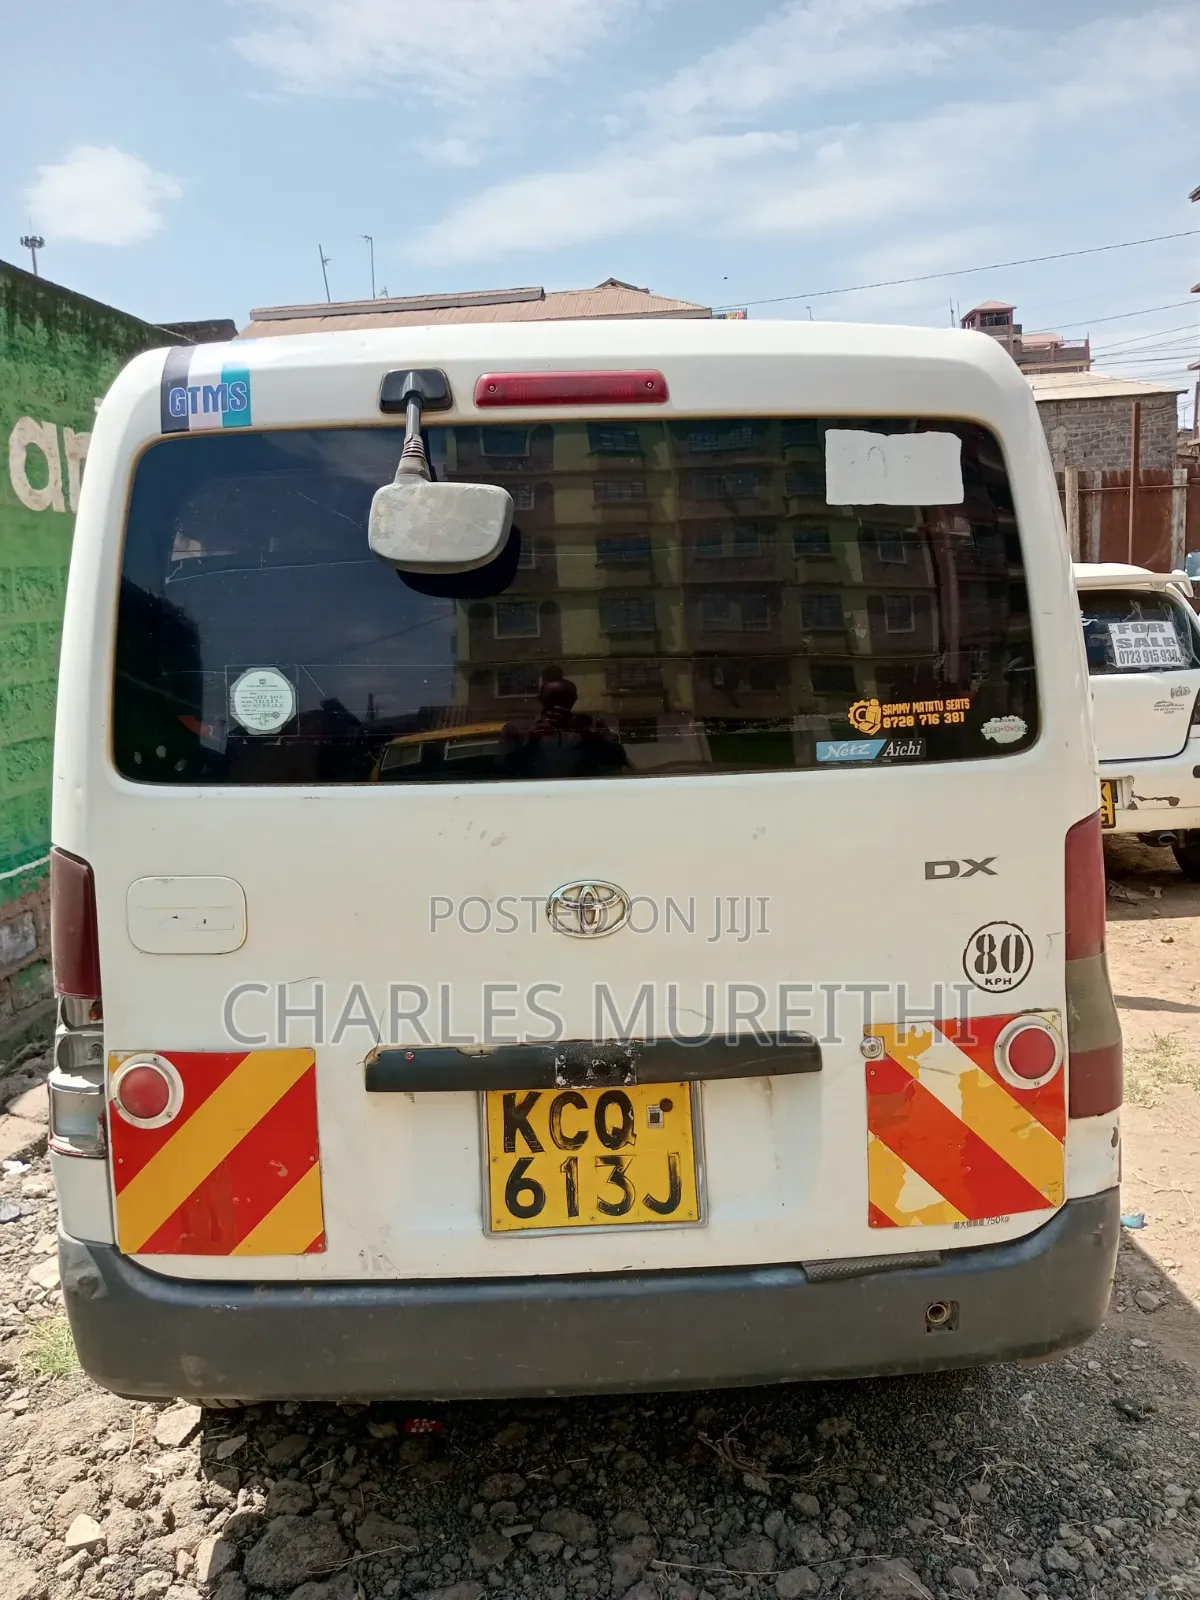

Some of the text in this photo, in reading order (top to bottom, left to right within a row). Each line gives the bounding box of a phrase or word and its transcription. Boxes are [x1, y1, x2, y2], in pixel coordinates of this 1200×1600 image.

[169, 381, 247, 417] GTMS
[1117, 623, 1165, 634] FOR
[1116, 637, 1176, 648] SALE
[1119, 650, 1141, 664] 0723
[1143, 649, 1159, 663] 915
[882, 698, 970, 715] SAMMY MATATU SEATS
[919, 713, 940, 725] 716
[944, 711, 965, 723] 381
[822, 741, 922, 760] Netz Aichi
[925, 856, 998, 880] DX
[974, 933, 1025, 975] 80
[984, 977, 1012, 986] KPH
[502, 1090, 637, 1154] KCQ
[504, 1152, 682, 1219] 613J
